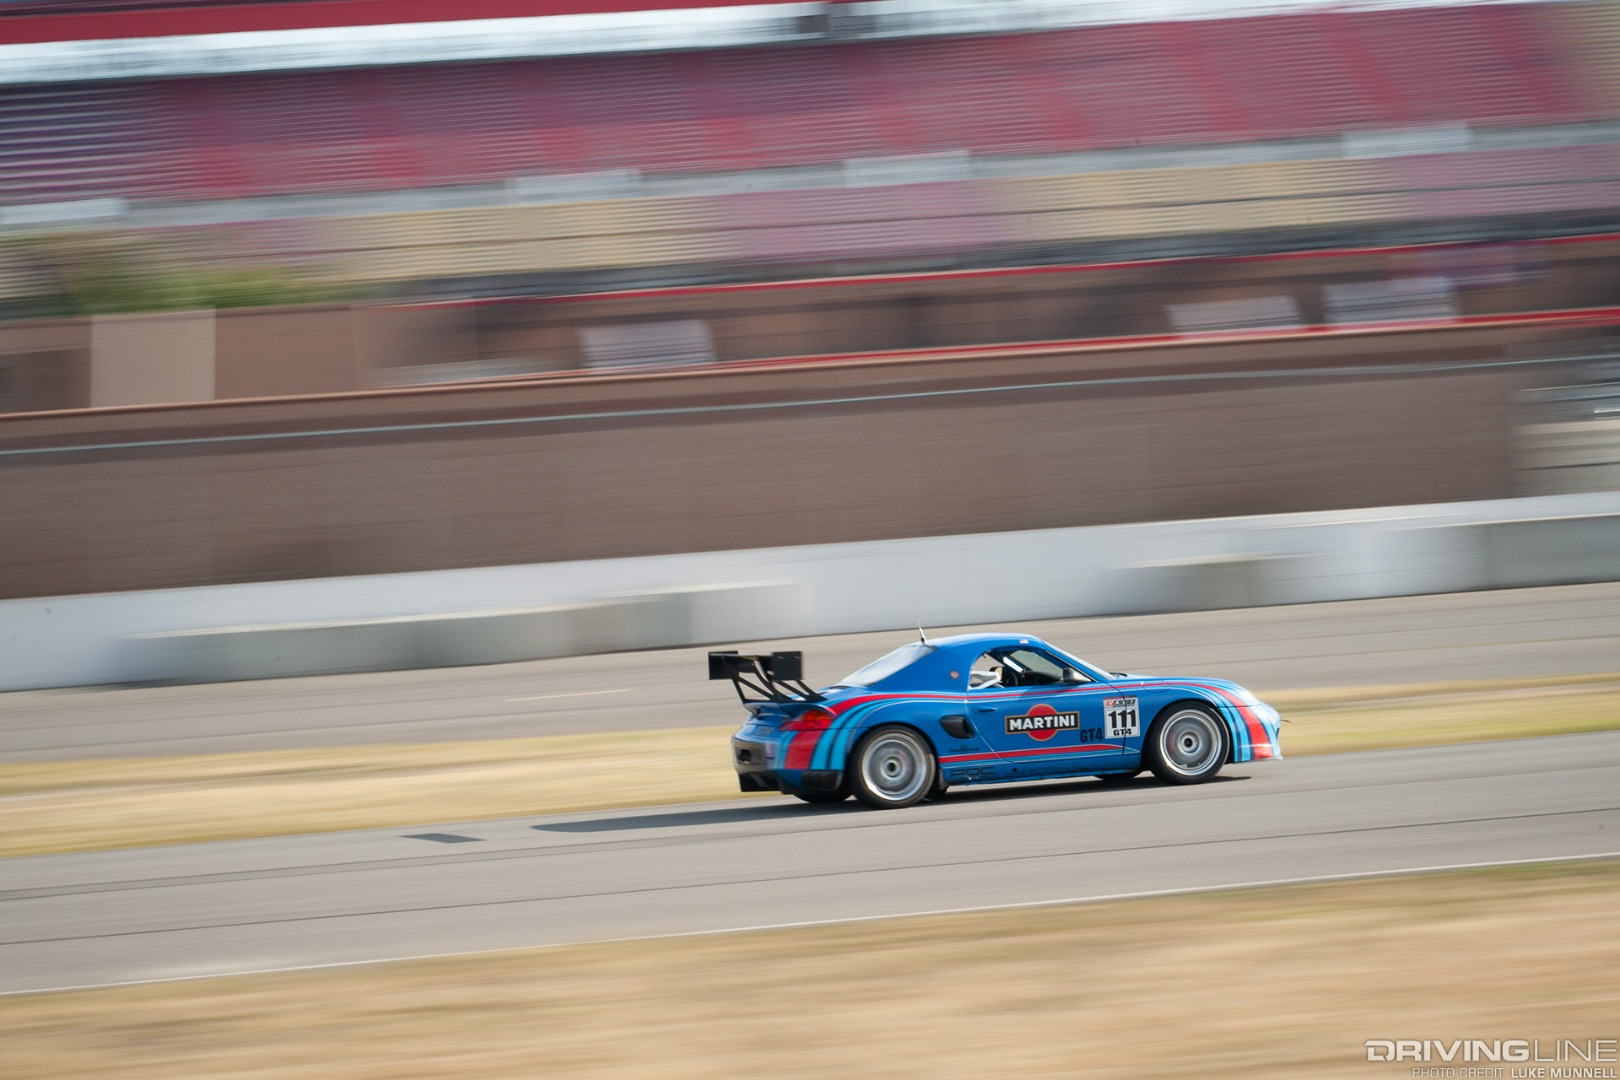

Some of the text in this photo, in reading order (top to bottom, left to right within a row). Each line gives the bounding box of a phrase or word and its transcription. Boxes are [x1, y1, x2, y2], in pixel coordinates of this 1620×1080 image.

[1009, 715, 1075, 730] MARTINI
[1108, 709, 1137, 728] 111
[1080, 728, 1102, 742] GT4
[1113, 728, 1132, 736] GT4
